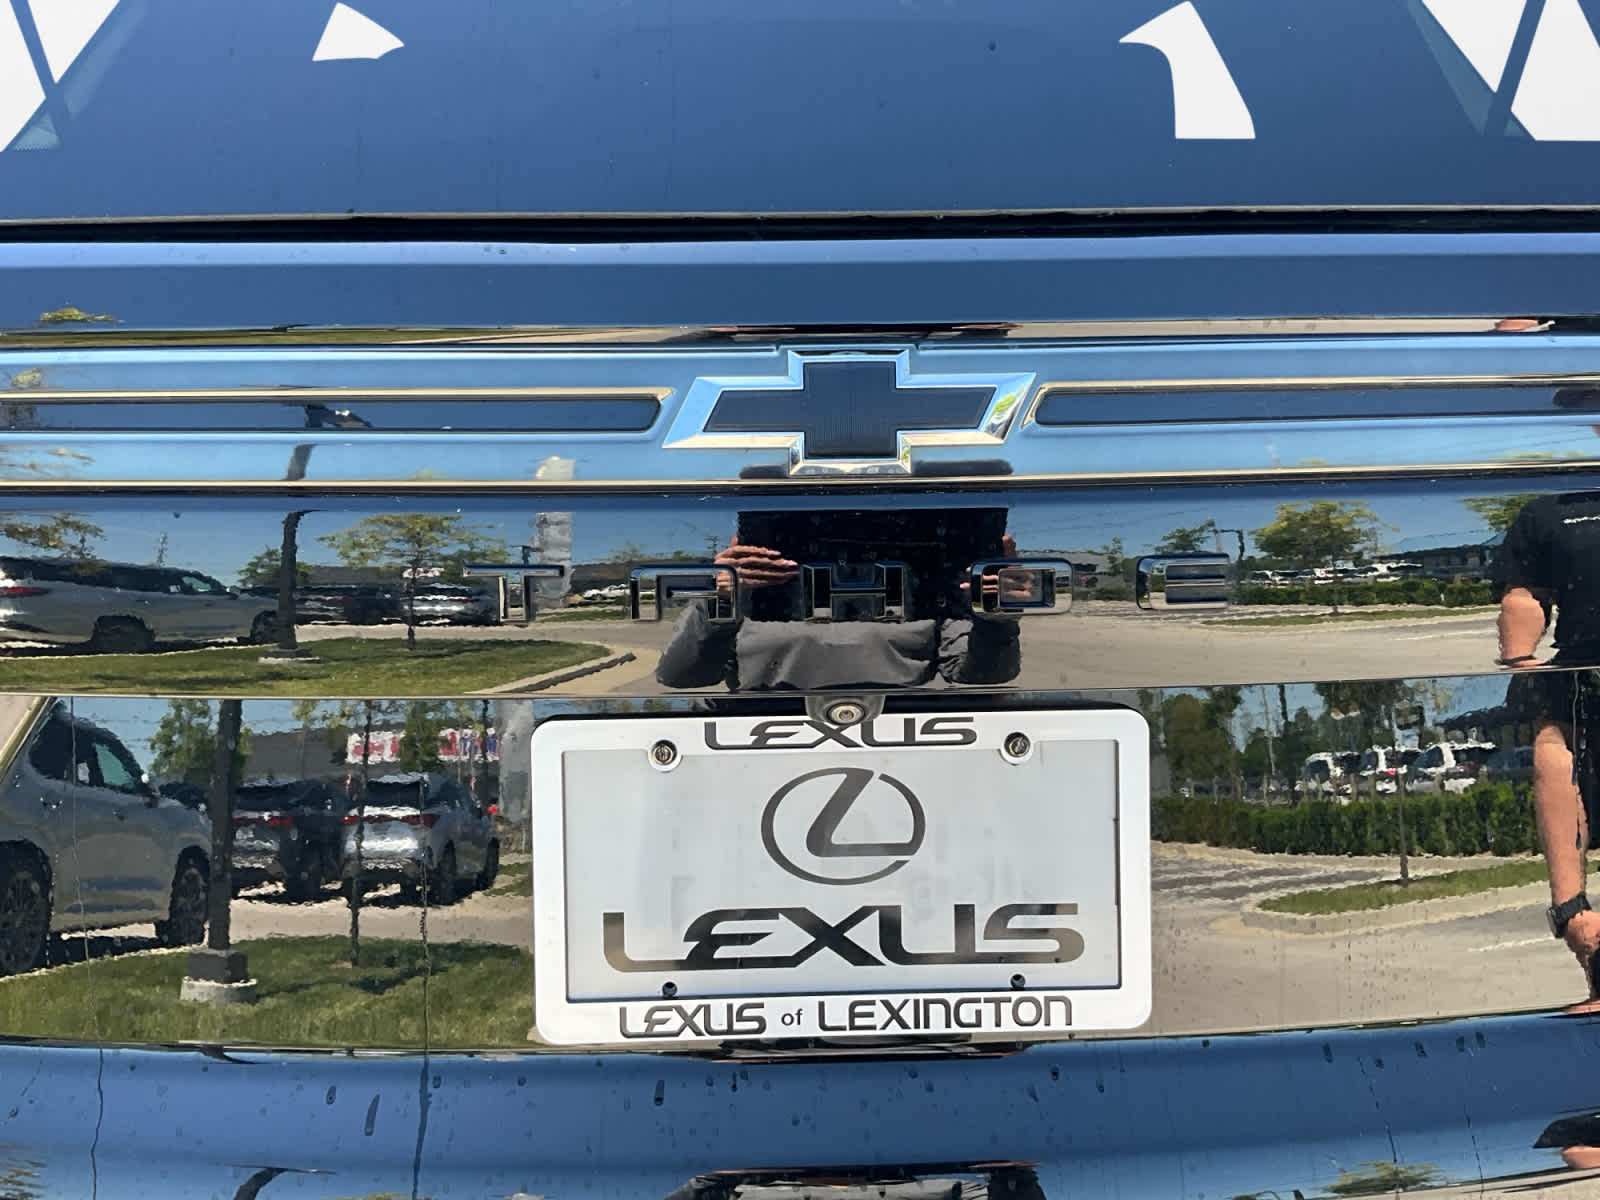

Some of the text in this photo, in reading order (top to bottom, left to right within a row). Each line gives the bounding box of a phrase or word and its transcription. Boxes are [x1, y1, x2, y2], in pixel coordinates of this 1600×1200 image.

[461, 553, 1230, 623] TAHOE
[704, 717, 976, 750] LEXUS
[602, 902, 1086, 973] LEXUS
[618, 995, 1073, 1039] LEXUS of LEXINGTON
